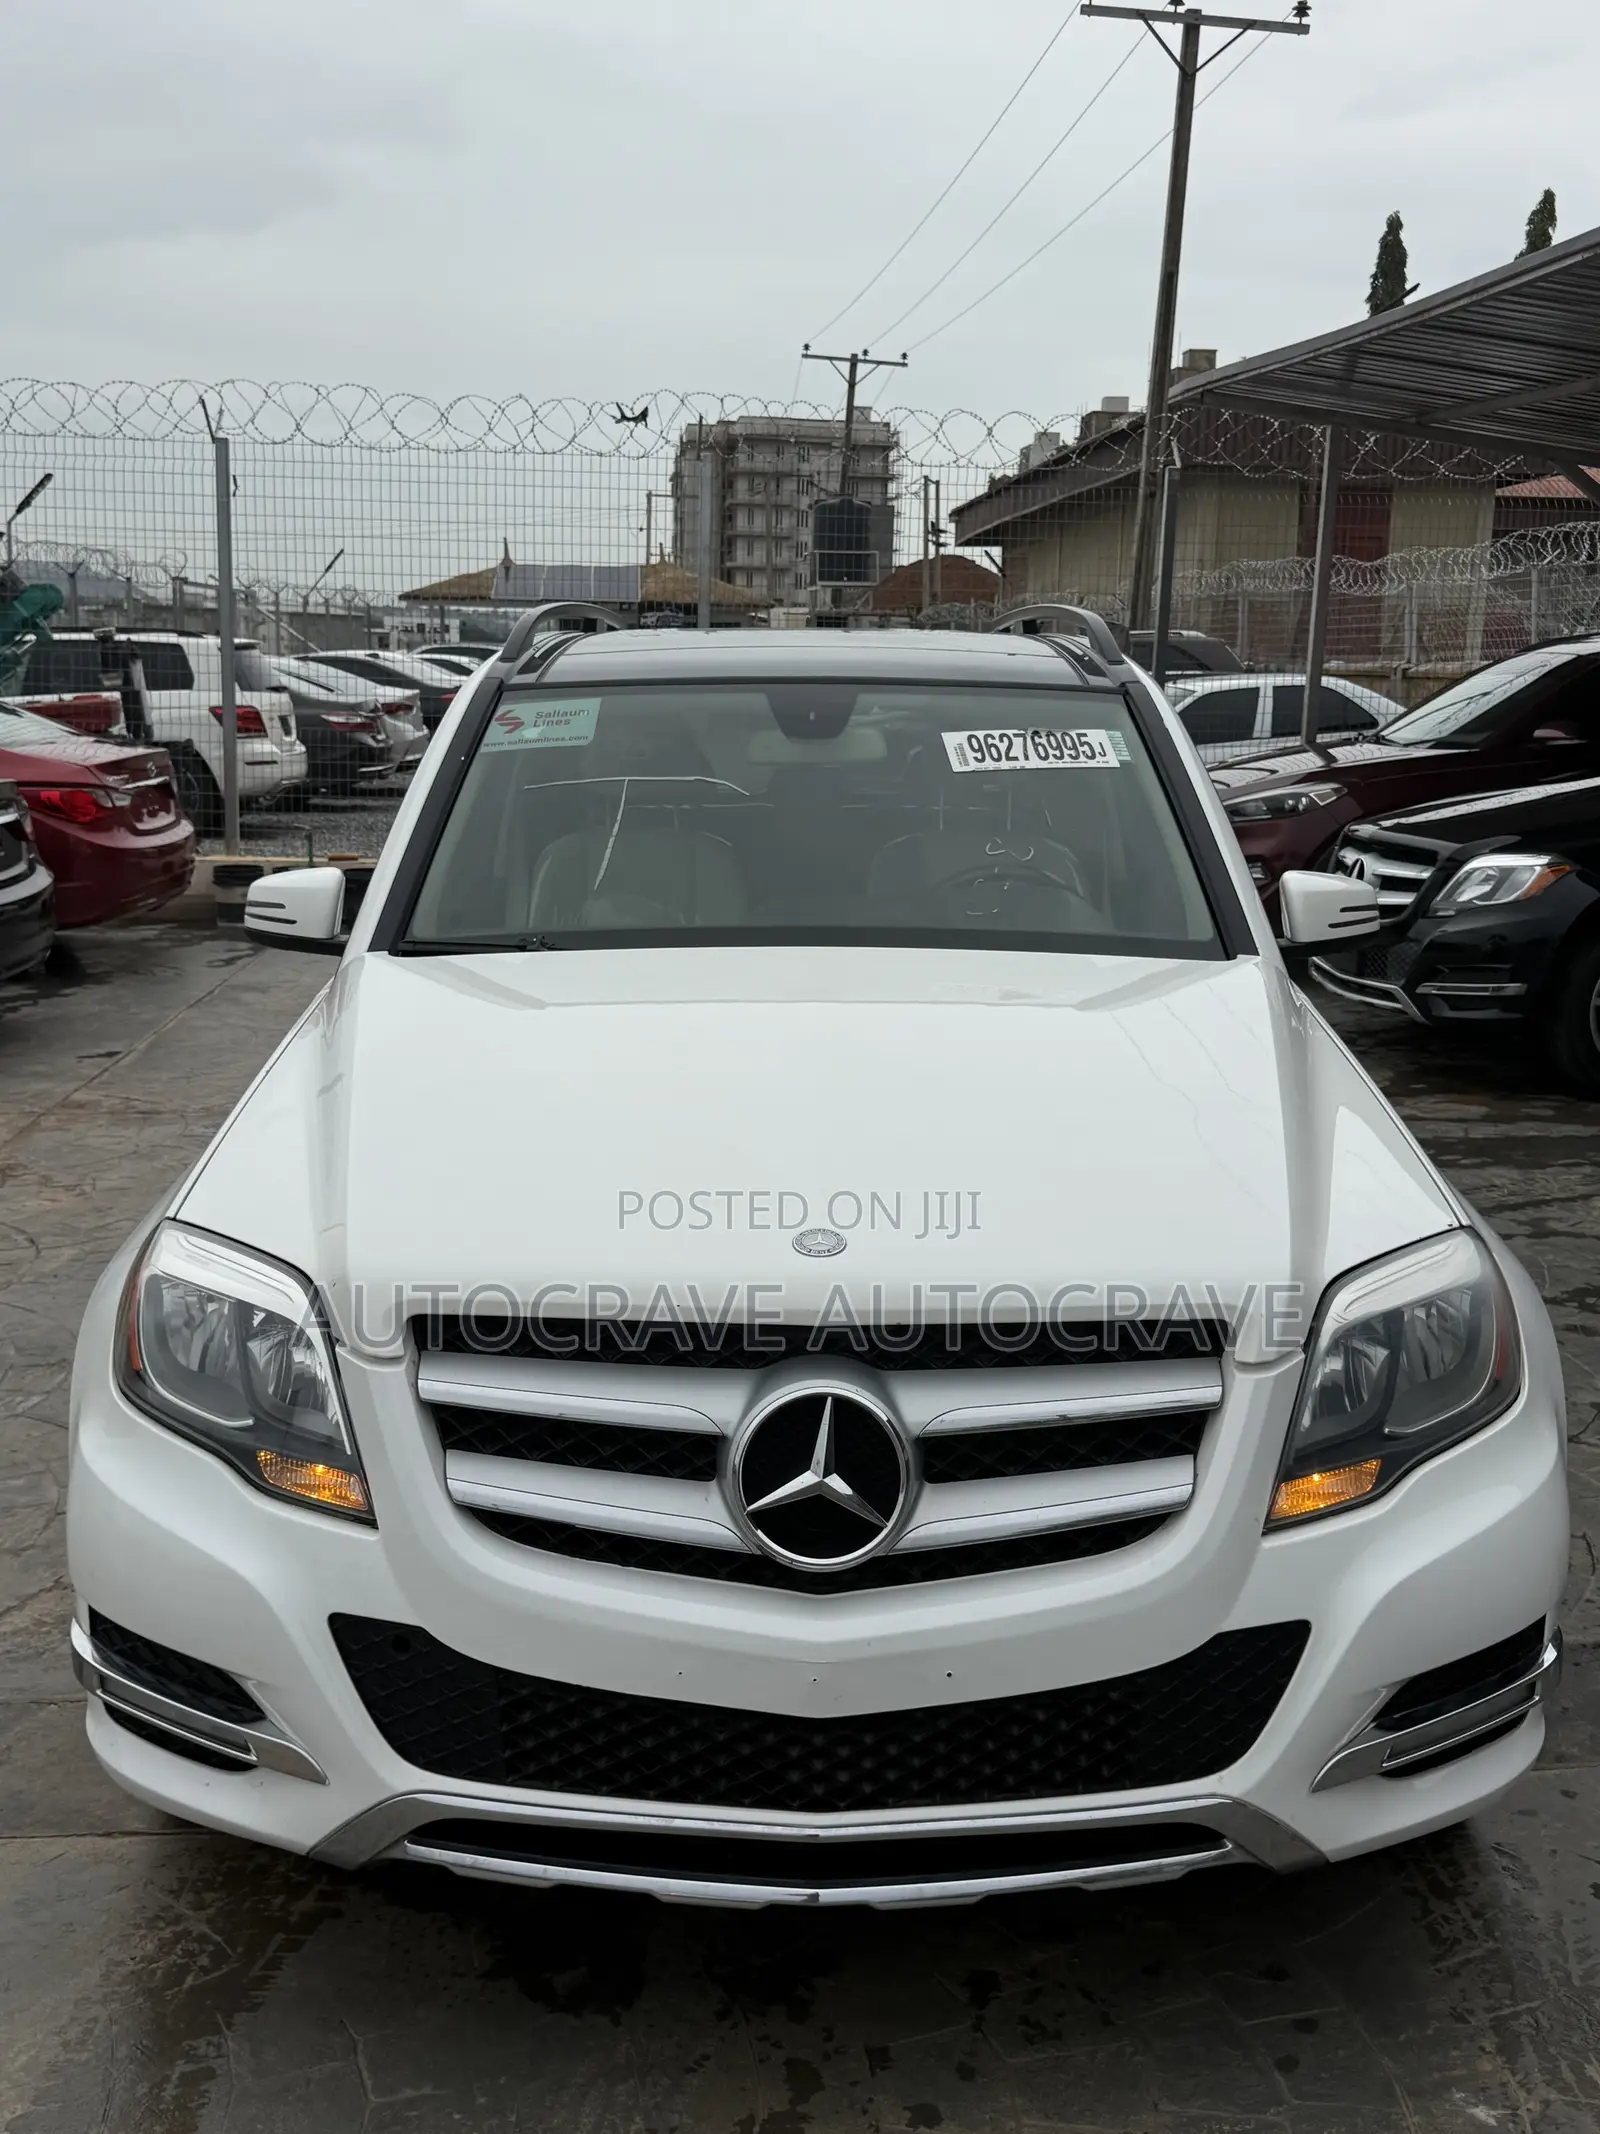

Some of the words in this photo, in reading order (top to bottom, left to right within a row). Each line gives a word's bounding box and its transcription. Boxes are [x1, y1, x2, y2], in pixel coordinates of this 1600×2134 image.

[534, 708, 590, 720] Sallaum
[533, 718, 571, 728] Lines
[483, 735, 588, 748] www.sallaumlines.com
